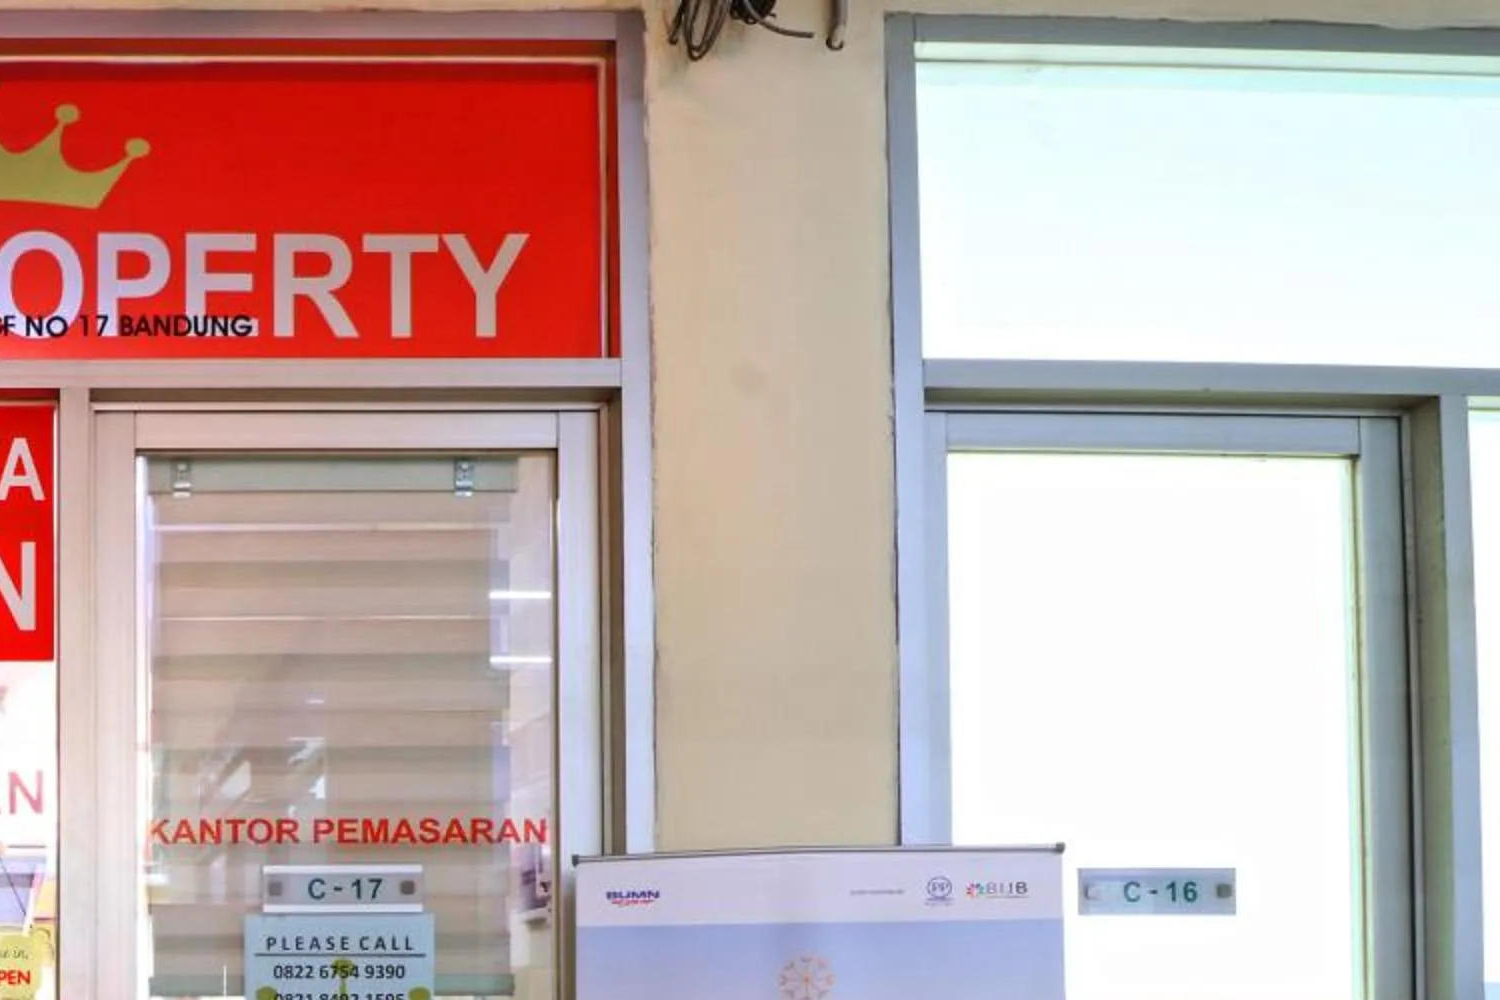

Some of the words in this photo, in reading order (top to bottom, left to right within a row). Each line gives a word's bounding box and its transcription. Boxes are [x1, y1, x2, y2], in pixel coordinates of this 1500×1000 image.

[25, 315, 70, 337] NO
[79, 314, 108, 337] 17
[118, 314, 254, 337] BANDUNG
[147, 818, 300, 846] KANTOR
[313, 818, 548, 846] PEMASARAN
[265, 936, 350, 951] PLEASE
[359, 936, 416, 951] CALL
[273, 965, 316, 979] 0822
[364, 965, 406, 979] 9390
